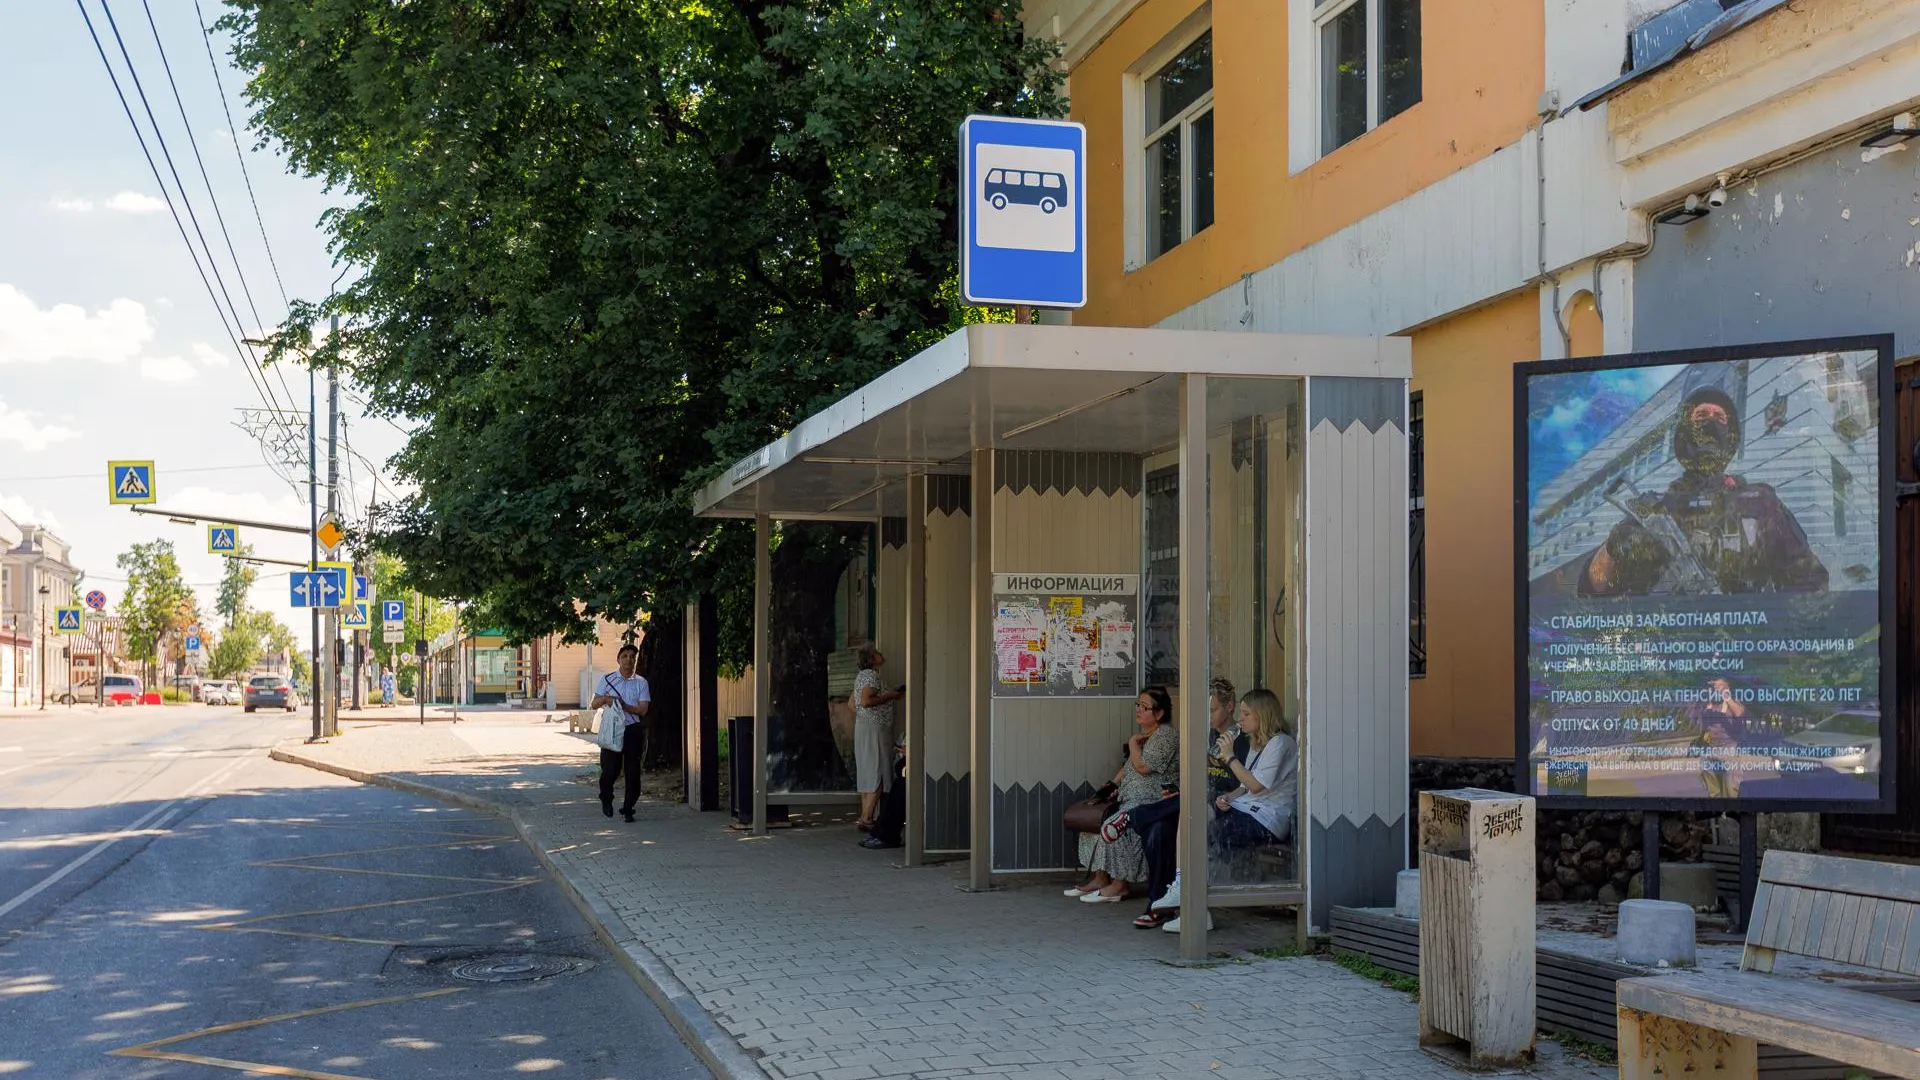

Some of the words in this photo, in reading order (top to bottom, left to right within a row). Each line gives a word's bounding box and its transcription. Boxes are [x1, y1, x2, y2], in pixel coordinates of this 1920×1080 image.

[1007, 577, 1124, 593] ИНФОРМАЦИЯ
[1551, 614, 1634, 629] СТАБИЛЬНАЯ
[1636, 611, 1721, 627] ЗАРАБОТНАЯ
[1723, 611, 1768, 625] ПЛАТА
[1550, 643, 1613, 656] ПОЛУЧЕНИЕ
[1615, 641, 1696, 655] БЕСПЛАТНОГО
[1699, 640, 1754, 653] ВЫСШЕГО
[1757, 639, 1845, 652] ОБРАЗОВАНИЯ
[1848, 638, 1855, 650] В
[1544, 660, 1593, 673] УЧЕБНЫХ
[1595, 659, 1666, 673] ЗАВЕДЕНИЯХ
[1669, 659, 1692, 672] МВД
[1695, 658, 1744, 671] РОССИИ
[1551, 690, 1592, 703] ПРАВО
[1595, 689, 1650, 704] ВЫХОДА
[1653, 689, 1674, 702] НА
[1675, 688, 1731, 702] ПЕНСИЮ
[1735, 688, 1755, 701] ПО
[1758, 687, 1816, 701] ВЫСЛУГЕ
[1819, 687, 1835, 701] 20
[1838, 687, 1863, 701] ЛЕТ
[1551, 718, 1600, 731] ОТПУСК
[1603, 717, 1620, 731] ОТ
[1623, 717, 1638, 731] 40
[1641, 715, 1675, 732] ДНЕЙ
[1620, 746, 1688, 757] СОТРУДНИКАМ
[1770, 746, 1832, 757] ОБЩЕЖИТИЕ
[1610, 760, 1651, 770] ВЫПЛАТА
